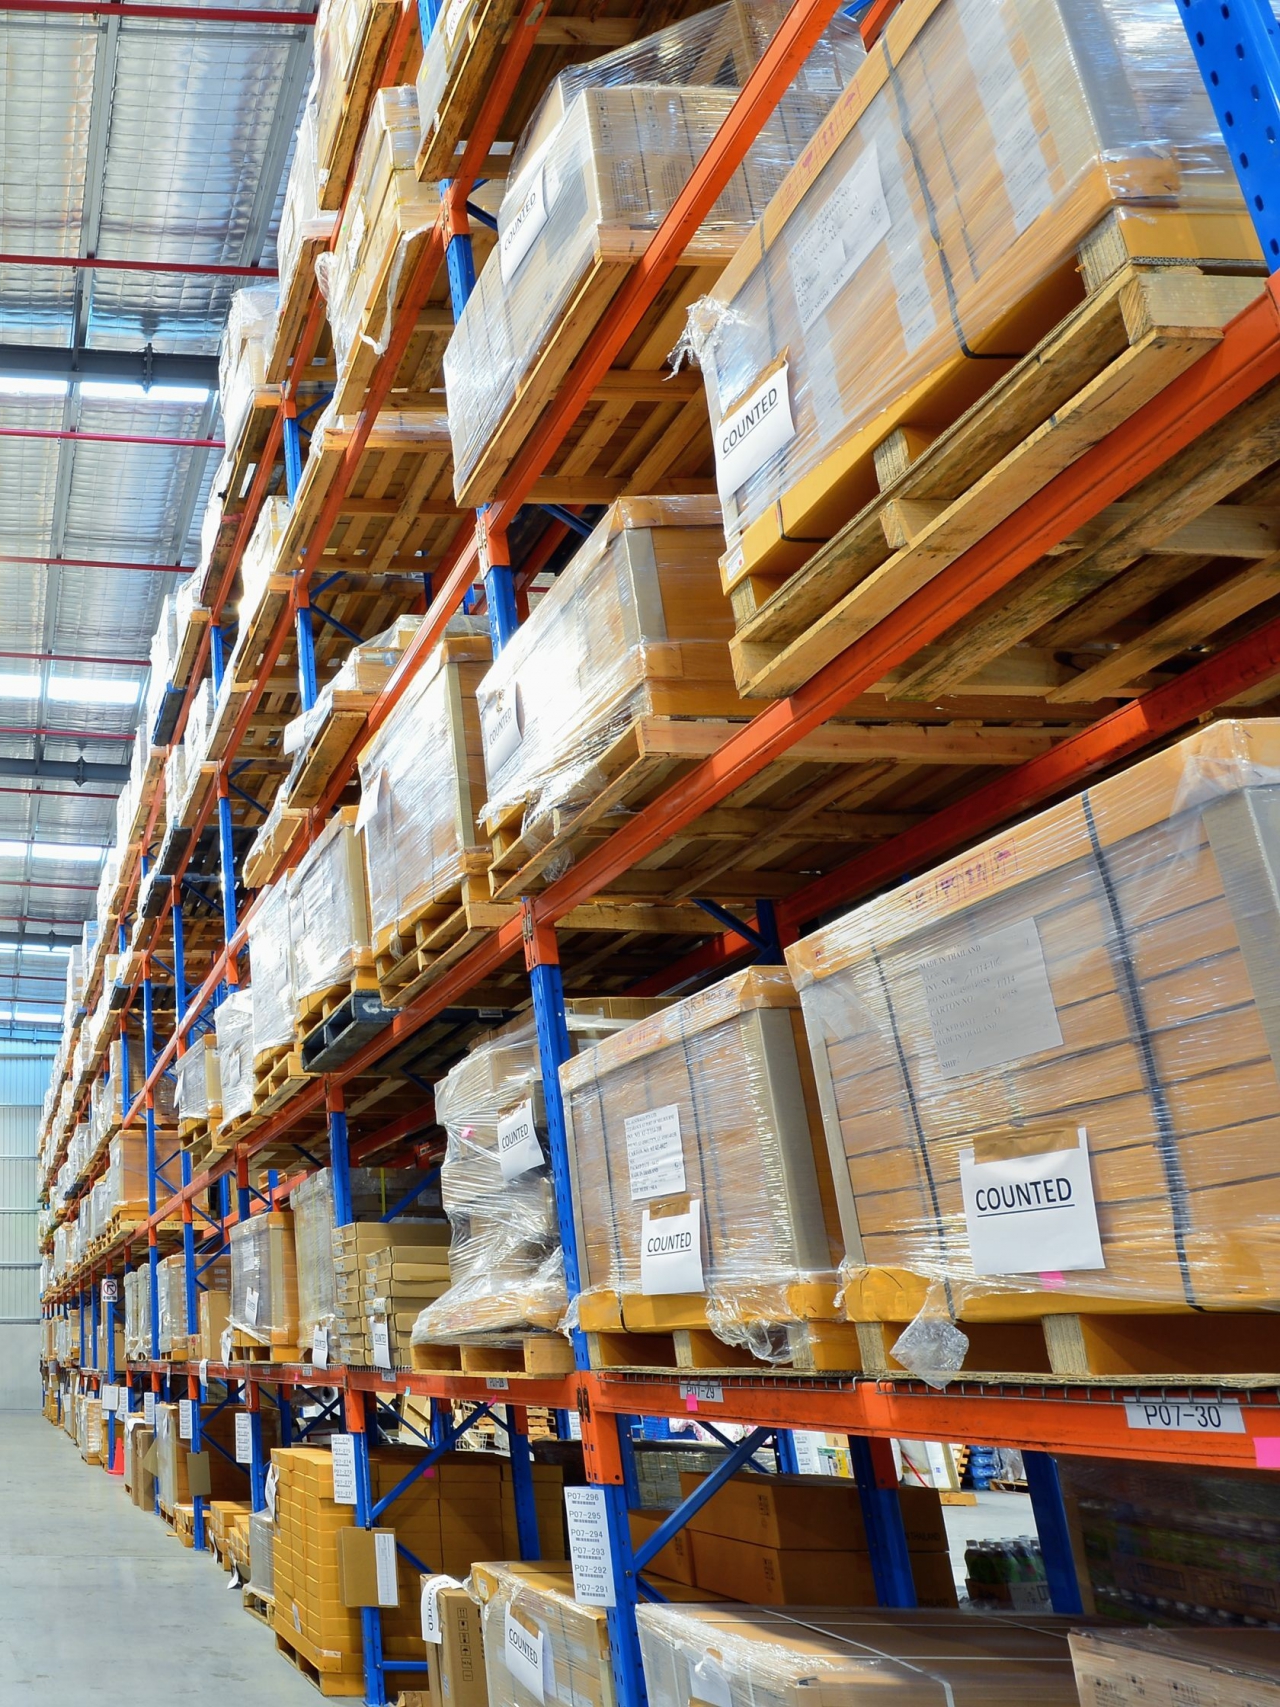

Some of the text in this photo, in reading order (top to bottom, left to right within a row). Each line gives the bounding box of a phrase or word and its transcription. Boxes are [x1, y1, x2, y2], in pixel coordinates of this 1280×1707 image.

[504, 193, 536, 250] COUNTED
[723, 388, 777, 454] COUNTED
[489, 707, 512, 745] COUNTED
[502, 1123, 529, 1149] COUNTED
[976, 1177, 1072, 1211] COUNTED
[647, 1232, 692, 1253] COUNTED
[1144, 1404, 1222, 1428] P07-30
[567, 1492, 599, 1501] P07-296
[569, 1510, 601, 1520] P07-295
[571, 1528, 603, 1538] P07-294
[572, 1546, 605, 1556] P07-293
[574, 1564, 607, 1575] P07-292
[576, 1582, 609, 1593] P07-291
[427, 1580, 449, 1631] COUNTED
[509, 1628, 538, 1664] COUNTED
